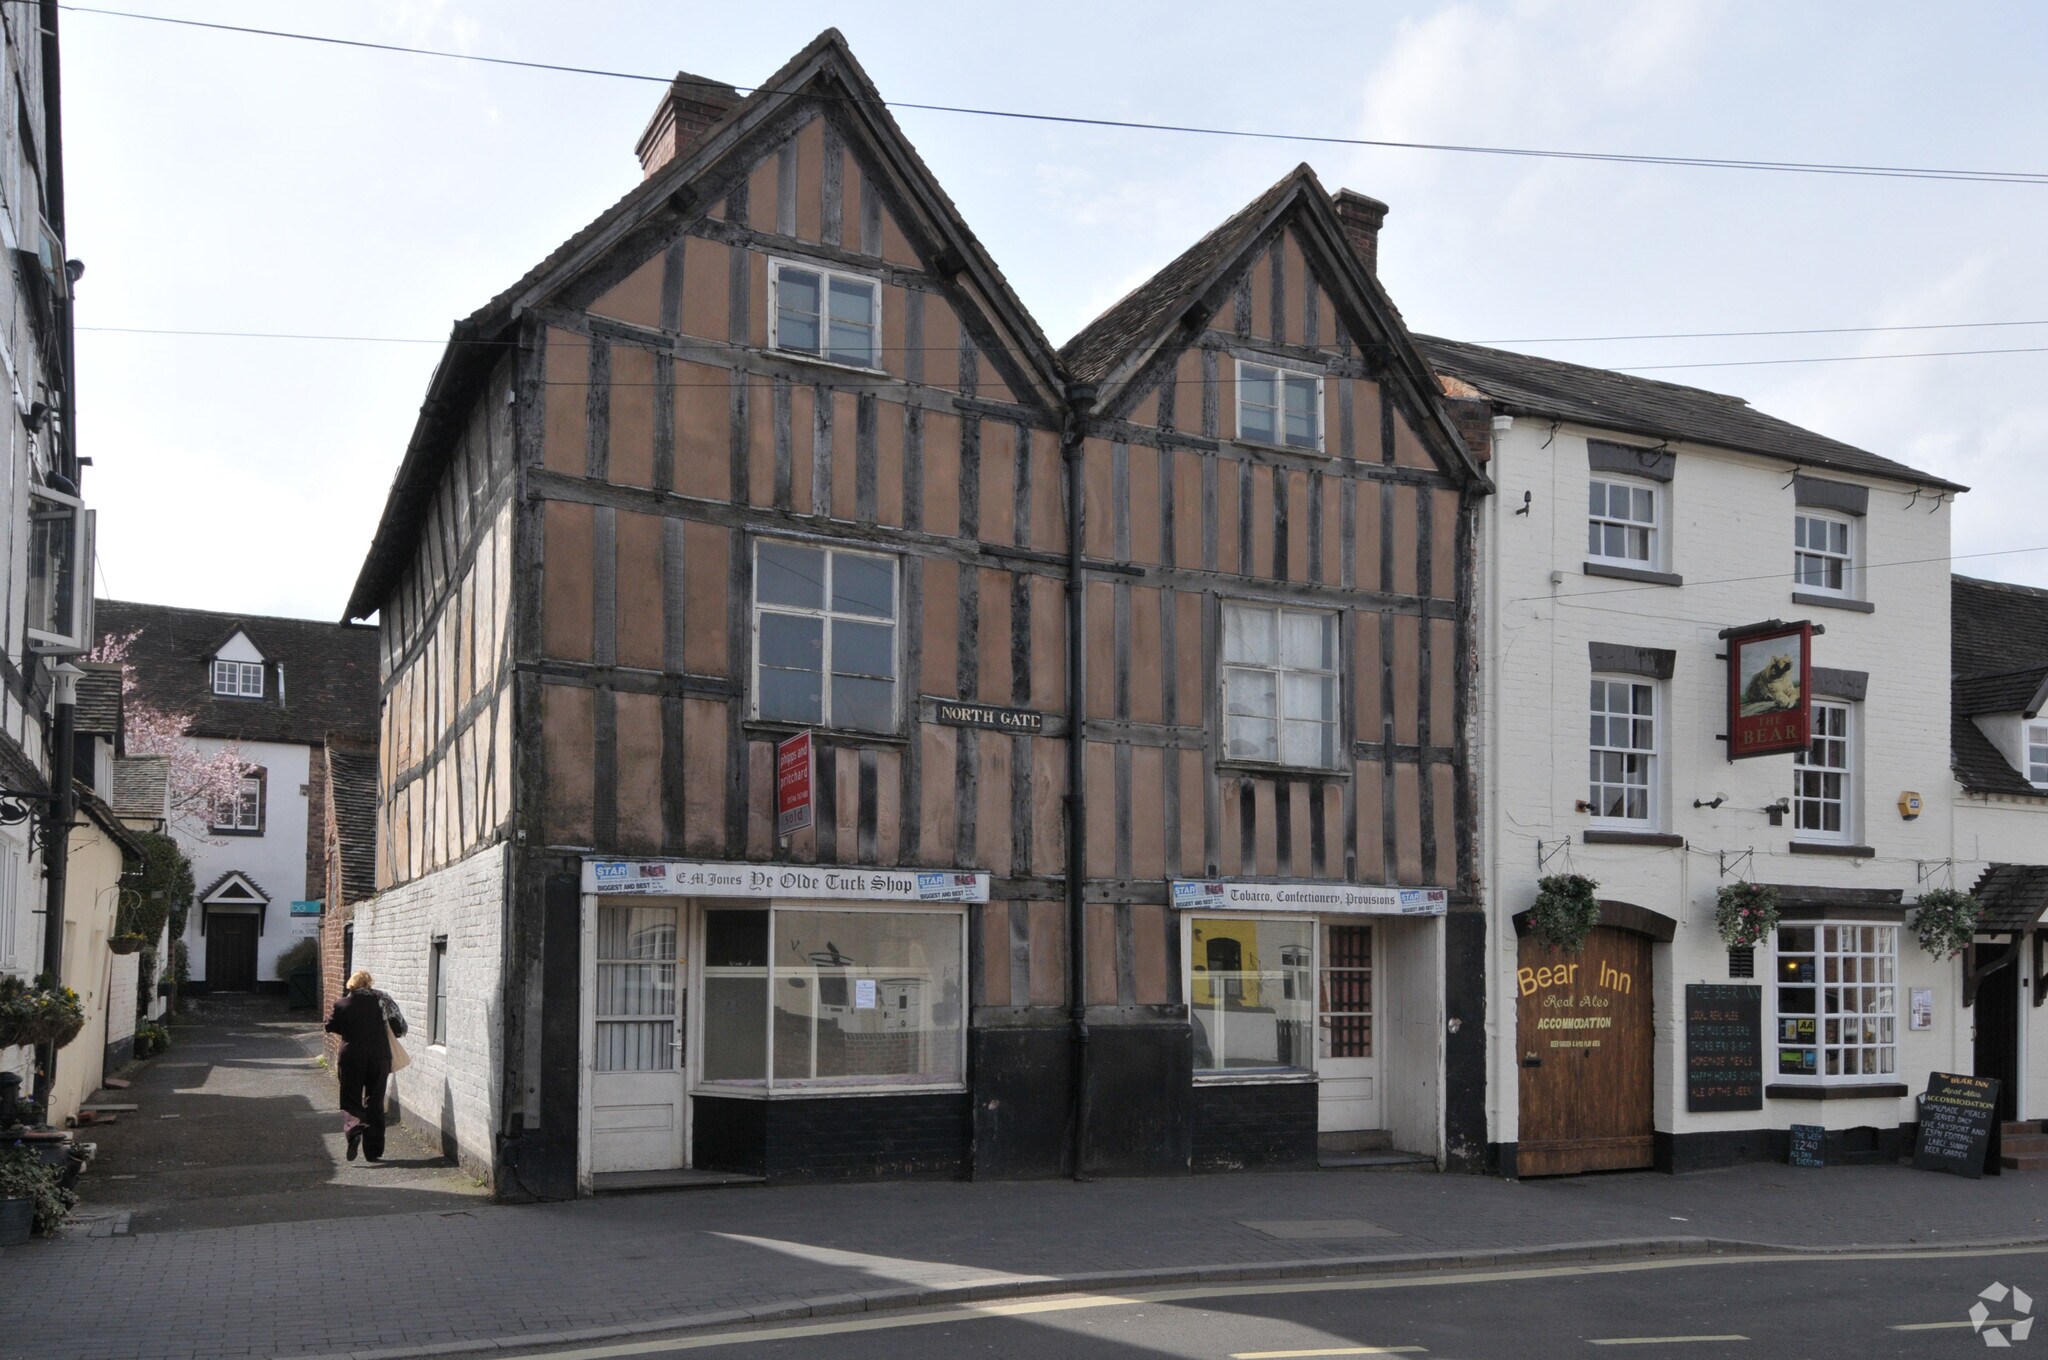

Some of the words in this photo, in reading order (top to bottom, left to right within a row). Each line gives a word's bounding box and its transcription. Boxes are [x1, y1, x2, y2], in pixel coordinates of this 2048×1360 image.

[942, 706, 993, 723] NORTH
[1000, 712, 1041, 727] GATE
[1760, 717, 1781, 726] THE
[1744, 724, 1798, 744] BEAR
[797, 743, 807, 758] and
[780, 768, 807, 790] pritchard
[785, 809, 803, 825] sold
[596, 865, 626, 876] STAR
[750, 871, 774, 891] Ye
[780, 873, 819, 889] Olde
[825, 873, 865, 890] Tuck
[871, 875, 912, 894] Shop
[919, 876, 943, 885] STAR
[597, 884, 622, 892] BIGGEST
[636, 882, 650, 890] BEST
[1174, 886, 1196, 894] STAR
[920, 892, 941, 900] BIGGEST
[1230, 889, 1272, 902] Tobacco,
[1345, 893, 1395, 905] Provisions
[1176, 900, 1193, 908] BIGGEST
[1517, 964, 1579, 996] Bear
[1600, 960, 1631, 994] Inn
[1543, 994, 1573, 1009] Real
[1579, 995, 1608, 1008] Ales
[1537, 1017, 1611, 1029] ACCOMMODATION
[1800, 1021, 1813, 1030] AA
[1739, 1041, 1752, 1052] SAT
[1730, 1055, 1753, 1067] MEALS
[1690, 1071, 1712, 1082] HAPPY
[1714, 1071, 1737, 1082] HOURS
[1950, 1077, 1973, 1085] BEAR
[1974, 1080, 1989, 1089] INN
[1942, 1087, 1962, 1095] Real
[1963, 1090, 1981, 1098] Ales
[1926, 1095, 1994, 1110] ACCOMMODATION
[1934, 1112, 1956, 1122] SERVED
[1963, 1109, 1987, 1119] MEALS
[1920, 1119, 1936, 1128] LIVE
[1971, 1128, 1986, 1136] AND
[1944, 1131, 1973, 1143] FOOTBALL
[1928, 1138, 1947, 1147] LARGE
[1949, 1141, 1969, 1150] SUNNY
[1924, 1145, 1940, 1154] BEER
[1942, 1149, 1968, 1158] GARDEN
